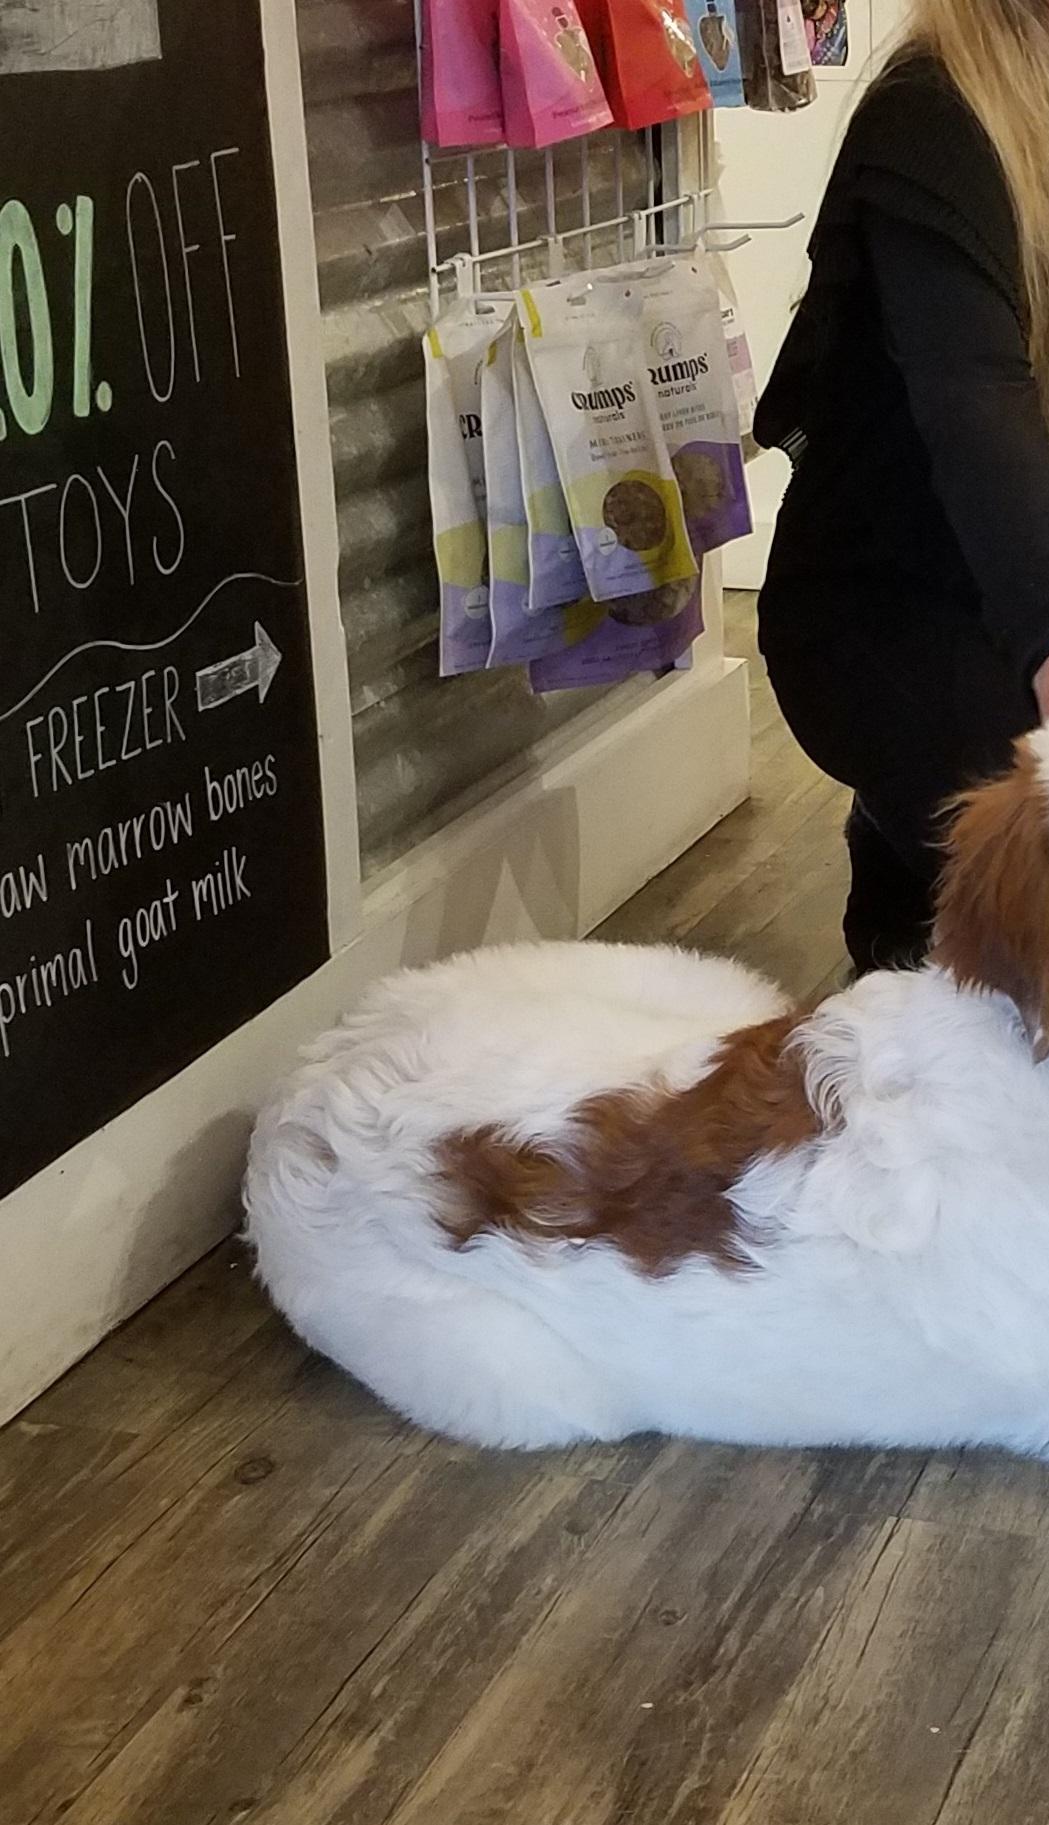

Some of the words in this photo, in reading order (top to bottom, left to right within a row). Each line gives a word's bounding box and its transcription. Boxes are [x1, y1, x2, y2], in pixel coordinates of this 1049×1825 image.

[0, 195, 112, 438] 0%
[127, 147, 240, 402] OFF
[657, 383, 697, 399] naturals
[0, 440, 184, 613] TOYS
[26, 665, 186, 798] FREEZER
[67, 793, 193, 890] marrow
[205, 752, 278, 822] bones
[0, 919, 99, 1057] primal
[118, 879, 180, 990] goat
[192, 846, 252, 920] milk
